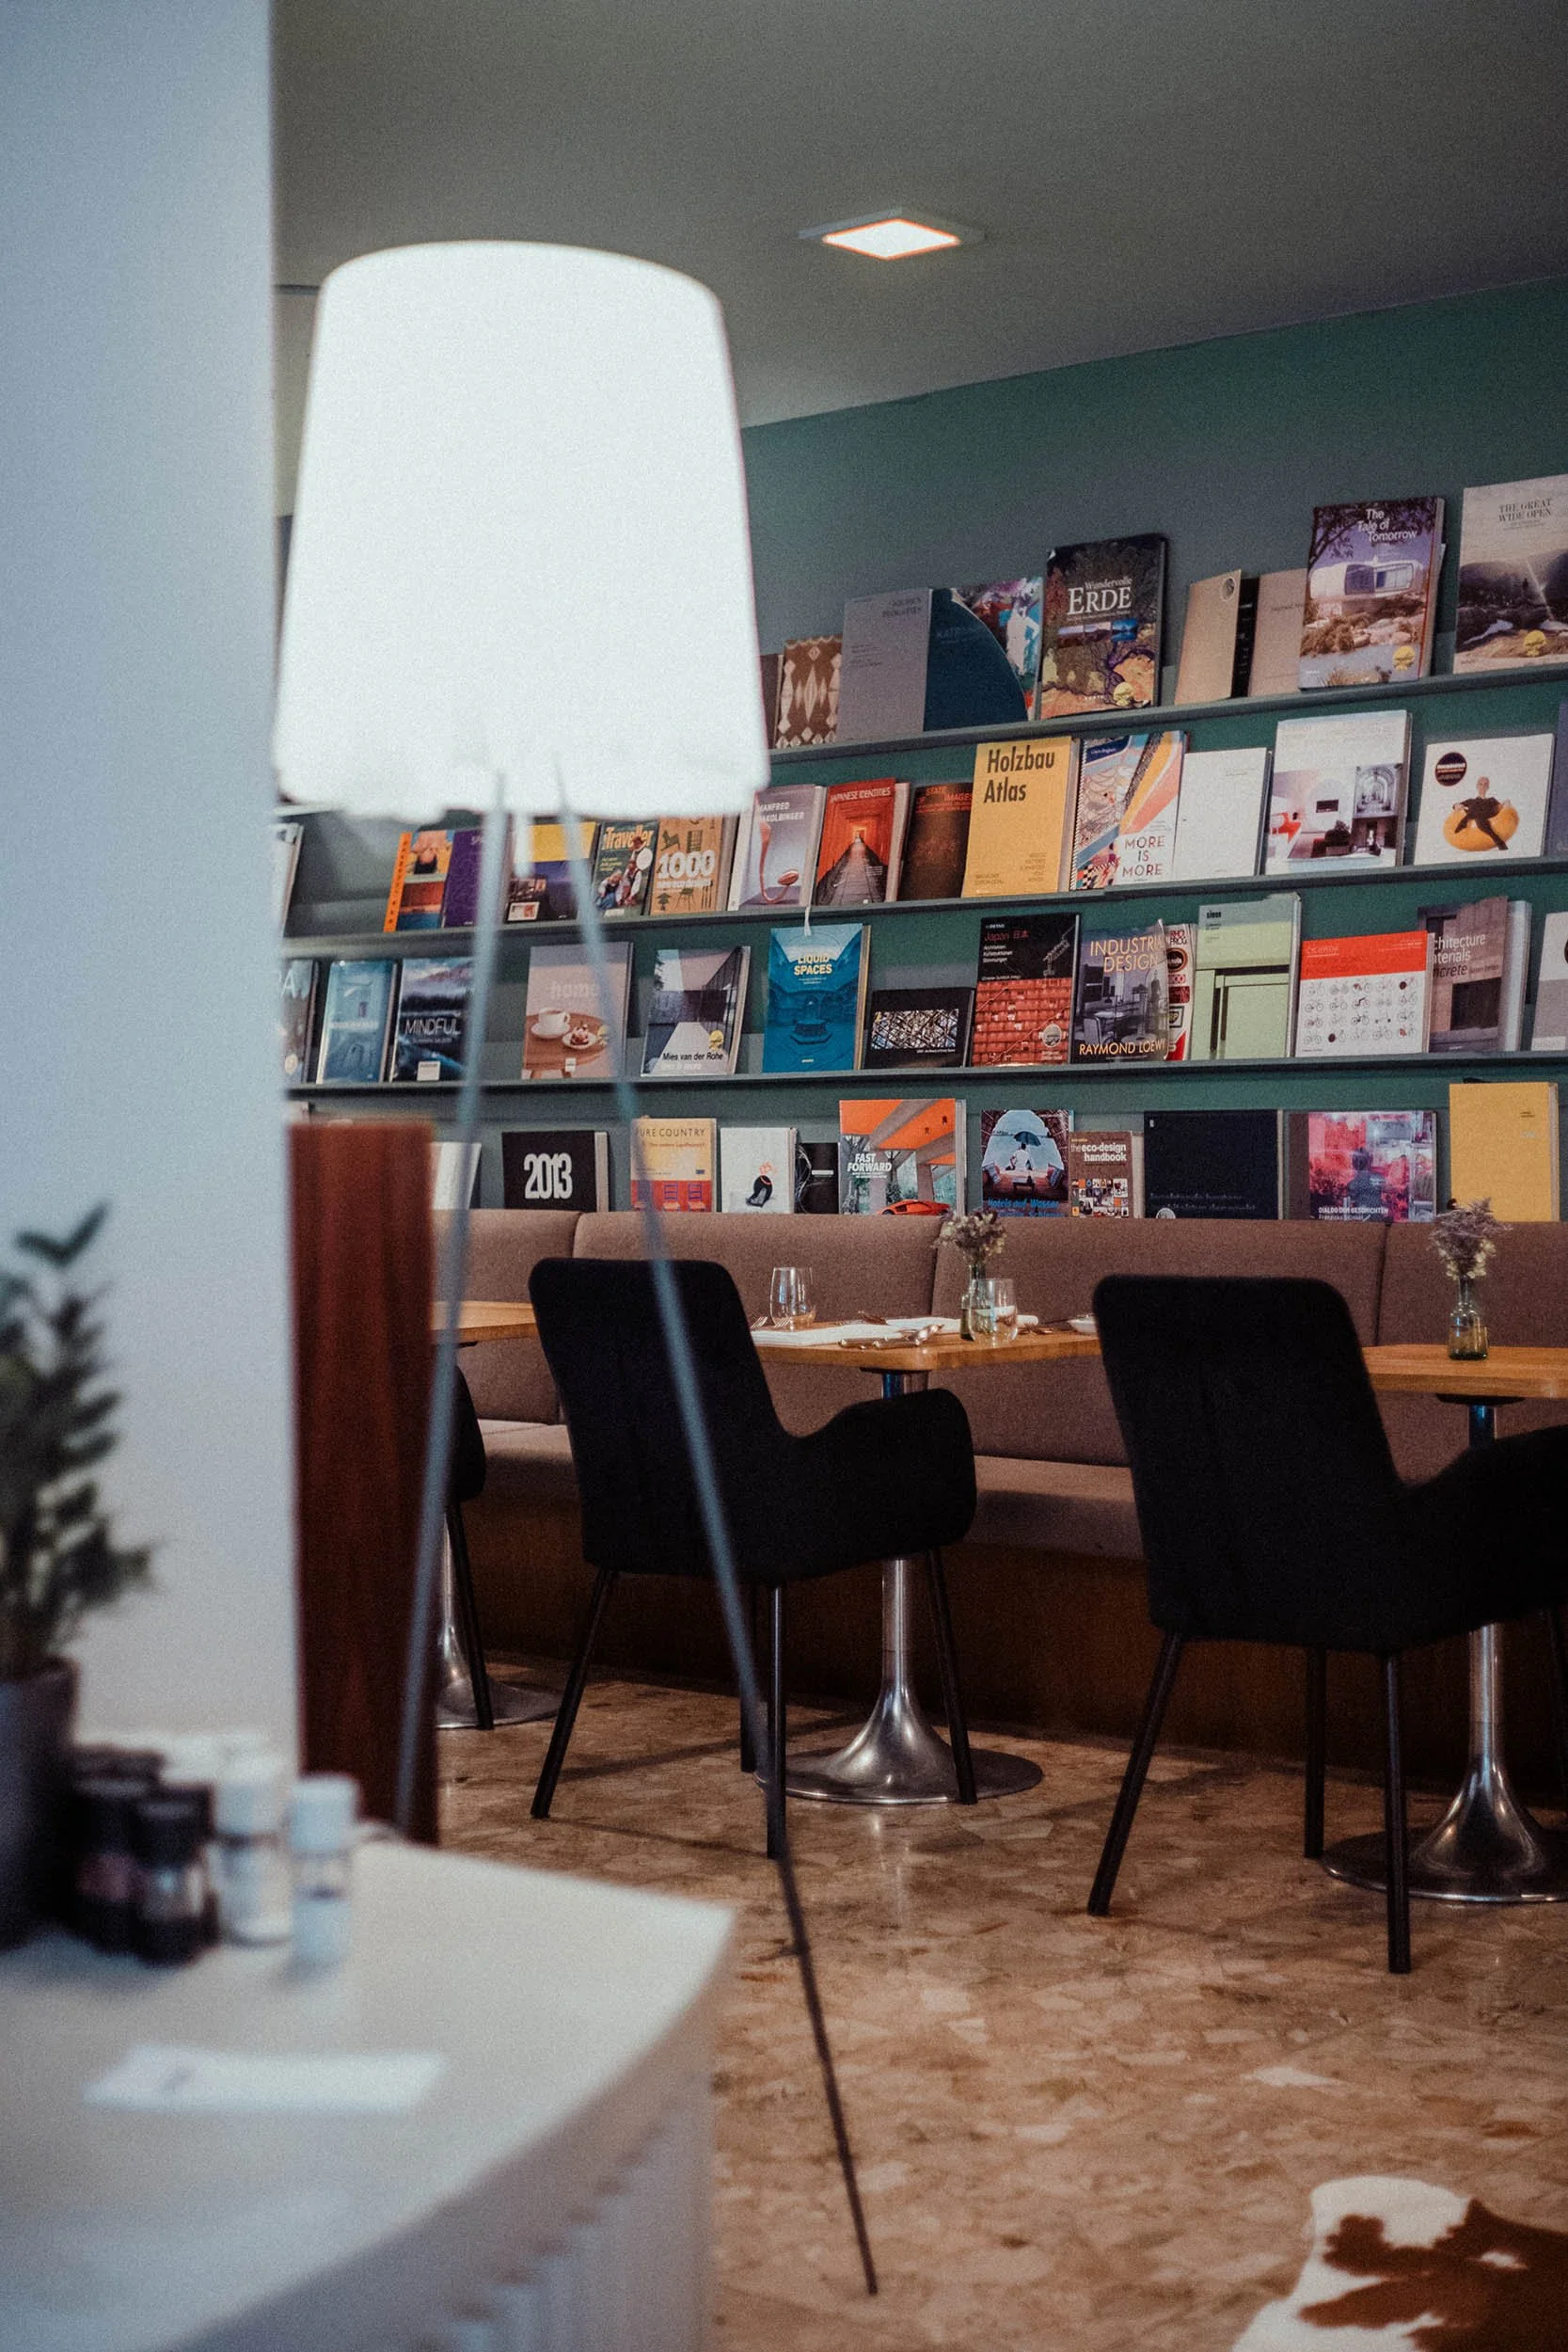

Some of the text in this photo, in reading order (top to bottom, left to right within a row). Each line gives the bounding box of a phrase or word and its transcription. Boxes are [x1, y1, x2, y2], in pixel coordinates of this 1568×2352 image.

[1366, 508, 1385, 519] The
[1498, 504, 1516, 513] THE
[1357, 518, 1390, 532] Tale of
[1368, 531, 1418, 543] Tomorrow
[1067, 587, 1132, 616] ERDE
[987, 744, 1055, 773] Holzbau
[984, 776, 1027, 803] Atlas
[831, 790, 858, 803] JAPANESE
[1124, 834, 1166, 850] MORE
[1137, 850, 1150, 863] IS
[658, 850, 716, 880] 1000
[1122, 864, 1164, 878] MORE
[798, 954, 830, 964] LIQUID
[1103, 953, 1158, 973] DESIGN
[794, 963, 832, 976] SPACES
[404, 1017, 461, 1035] MINDFUL
[1079, 1041, 1136, 1056] RAYMOND
[1139, 1038, 1165, 1054] LOEWY
[693, 1052, 705, 1060] der
[706, 1051, 723, 1061] Rohe
[658, 1128, 705, 1137] COUNTRY
[1081, 1142, 1127, 1153] eco-design
[855, 1152, 877, 1163] FAST
[1084, 1152, 1127, 1162] handbook
[847, 1162, 893, 1172] FORWARD
[524, 1152, 573, 1200] 2013
